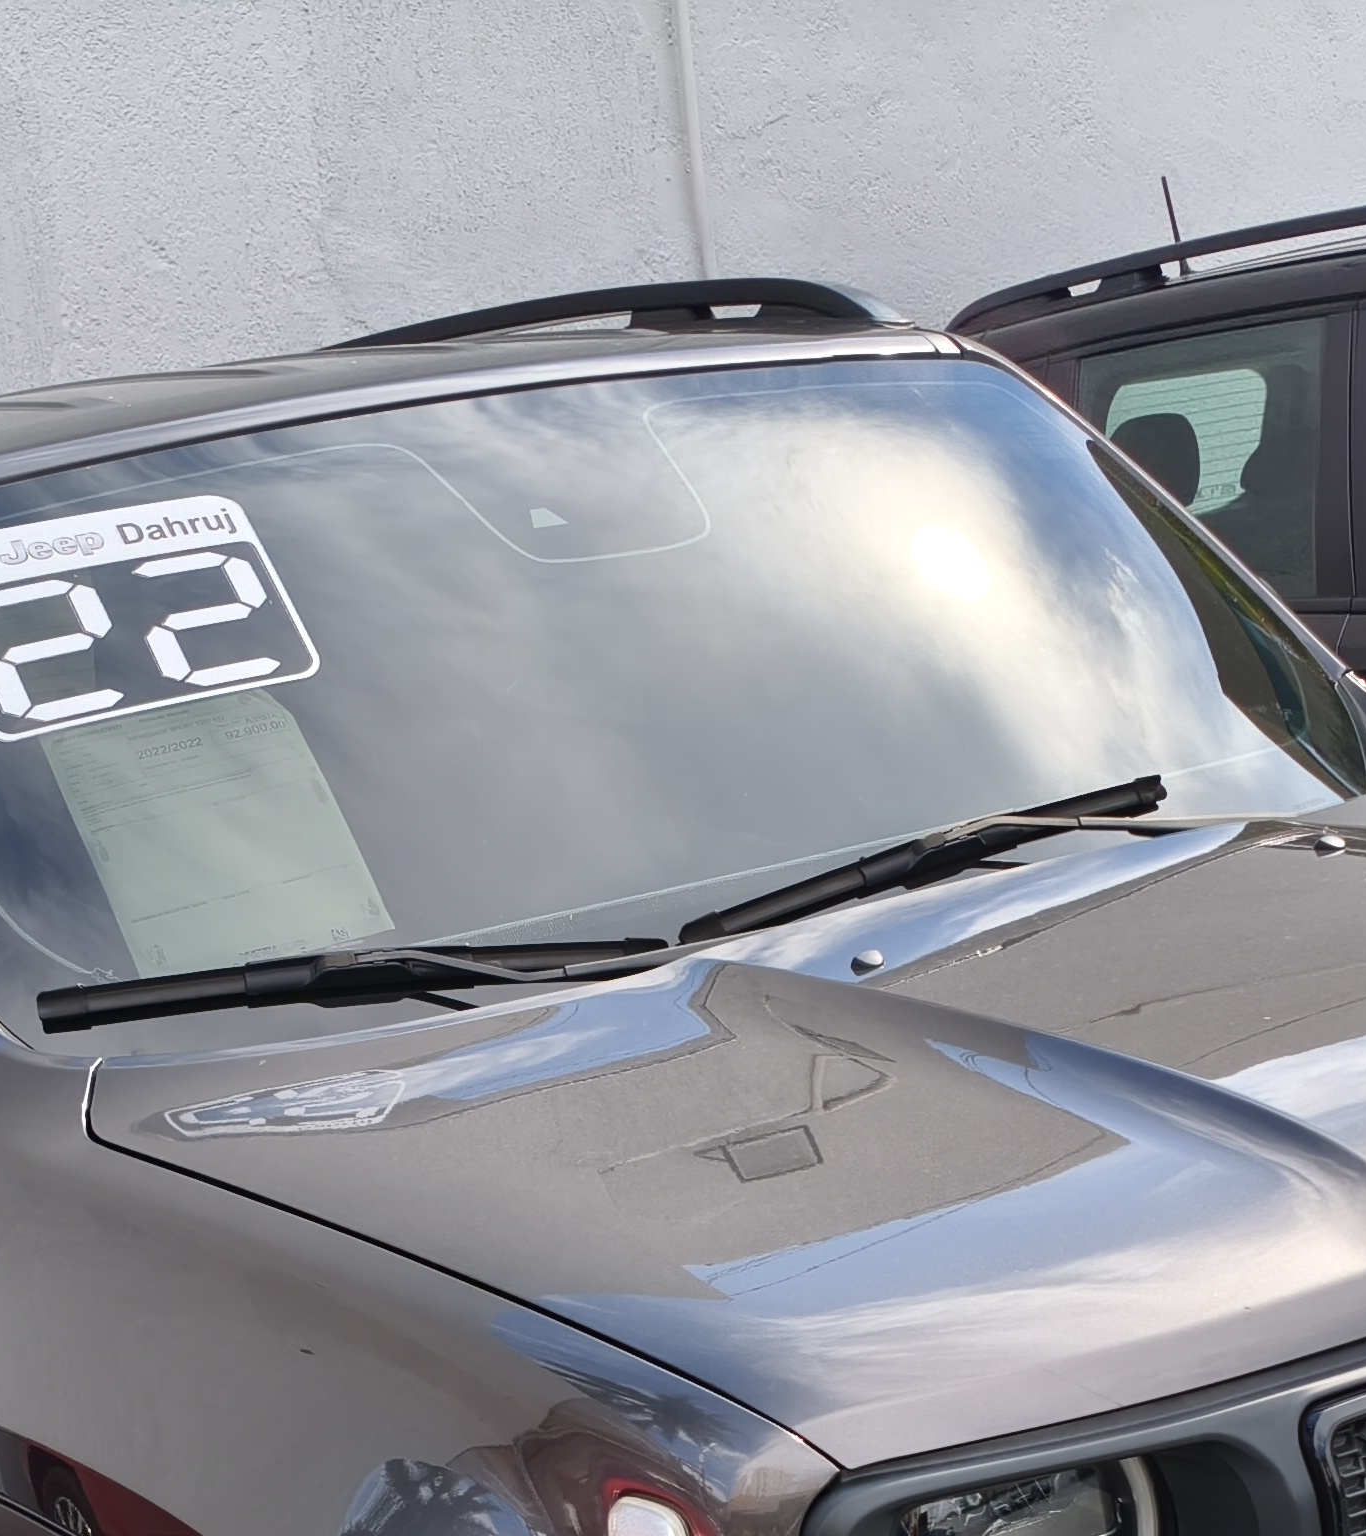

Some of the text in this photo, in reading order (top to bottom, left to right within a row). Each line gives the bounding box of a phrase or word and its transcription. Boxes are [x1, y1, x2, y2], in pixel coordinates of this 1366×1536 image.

[0, 508, 237, 566] Jeep Dahruj
[225, 720, 286, 740] 92.900,00
[137, 737, 203, 760] 2022/2022
